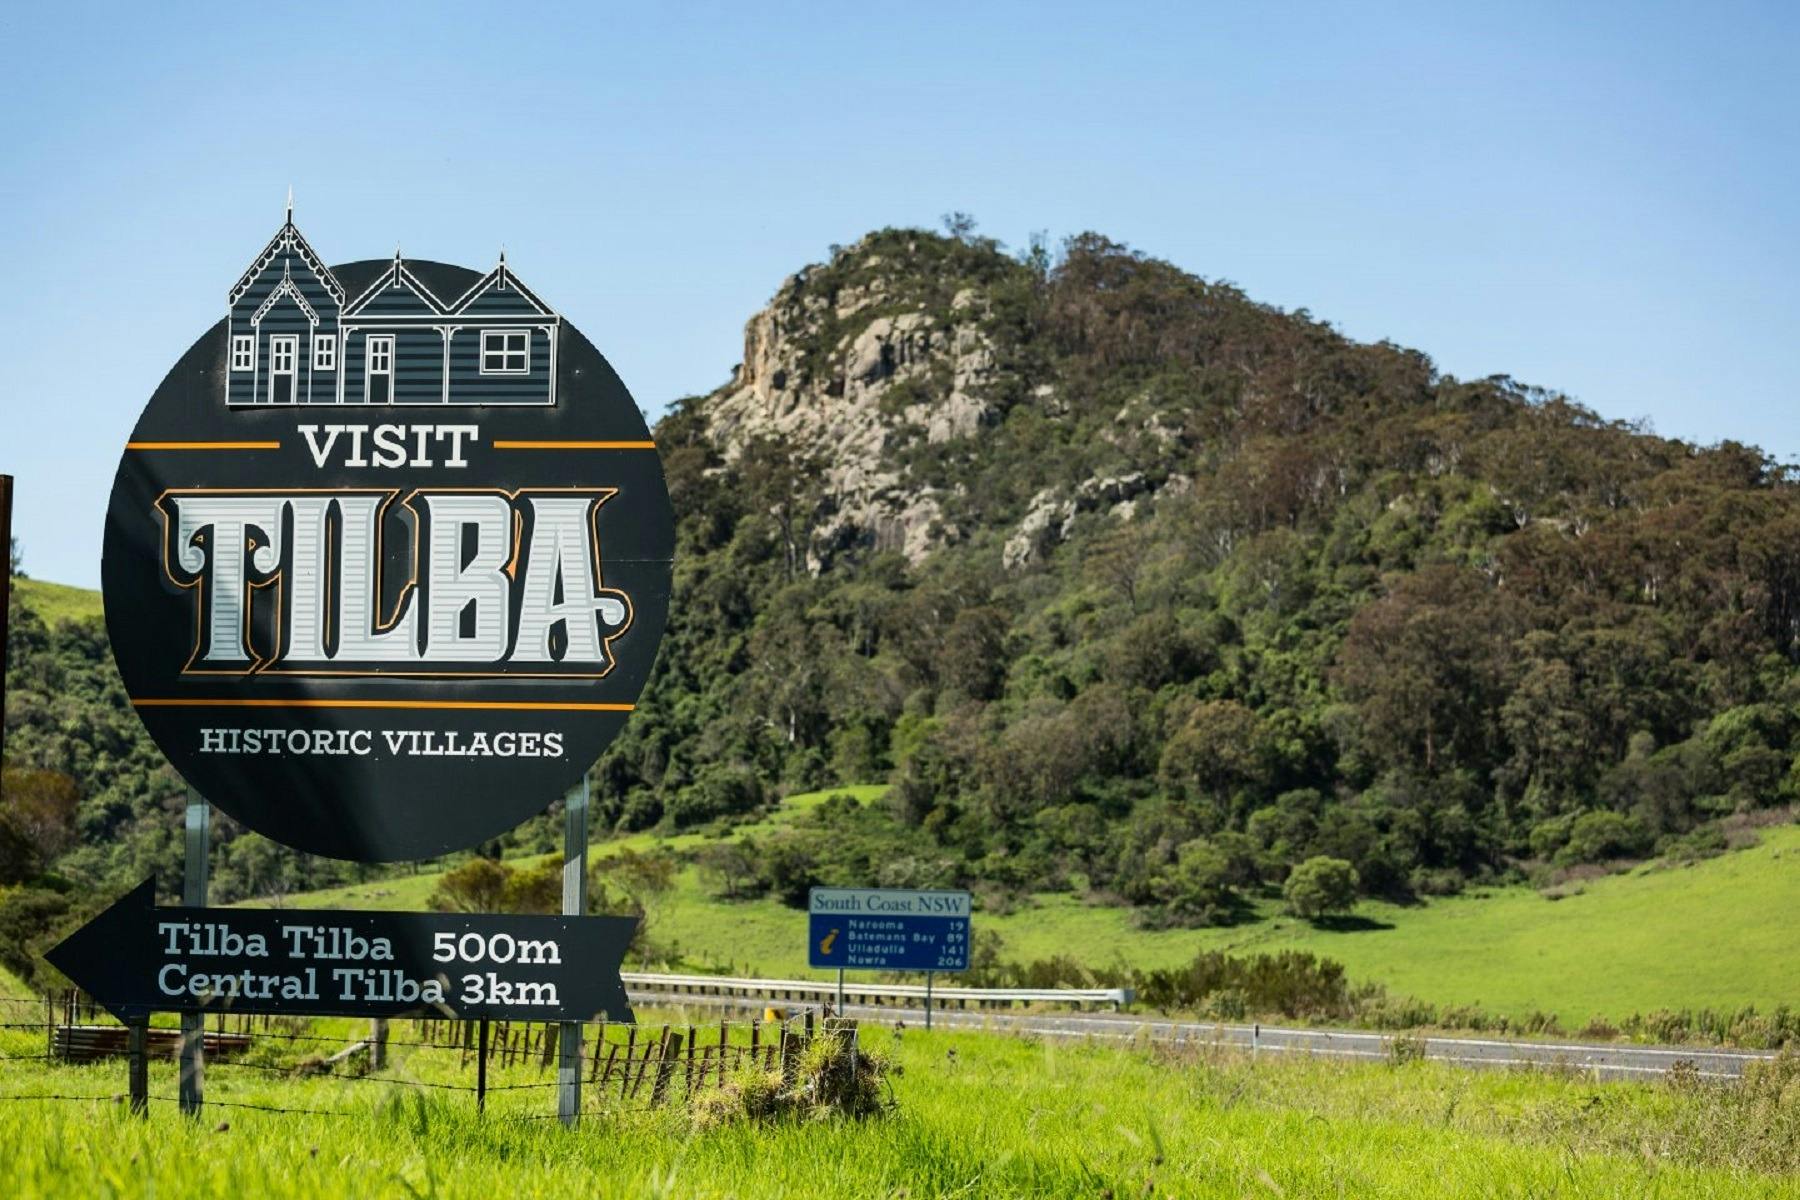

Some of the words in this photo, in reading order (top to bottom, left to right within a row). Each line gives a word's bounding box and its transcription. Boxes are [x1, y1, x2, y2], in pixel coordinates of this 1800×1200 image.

[297, 424, 480, 469] VISIT
[172, 494, 627, 664] TILBA
[199, 727, 373, 756] HISTORIC
[382, 729, 565, 758] VILLAGES
[814, 893, 861, 911] South
[867, 895, 912, 911] Coast
[918, 897, 964, 913] NSW
[848, 919, 904, 930] Narooma
[949, 922, 964, 931] 19
[848, 931, 906, 941] Batemans
[913, 933, 936, 944] Bay
[946, 934, 964, 943] 89
[158, 921, 269, 958] Tilba
[282, 925, 395, 961] Tilba
[432, 931, 562, 966] 500m
[848, 943, 905, 954] Ulladulla
[942, 946, 964, 955] 141
[848, 955, 887, 965] Nowra
[938, 957, 963, 966] 206
[158, 962, 320, 1001] Central
[332, 968, 445, 1005] Tilba
[460, 972, 561, 1007] 3km
